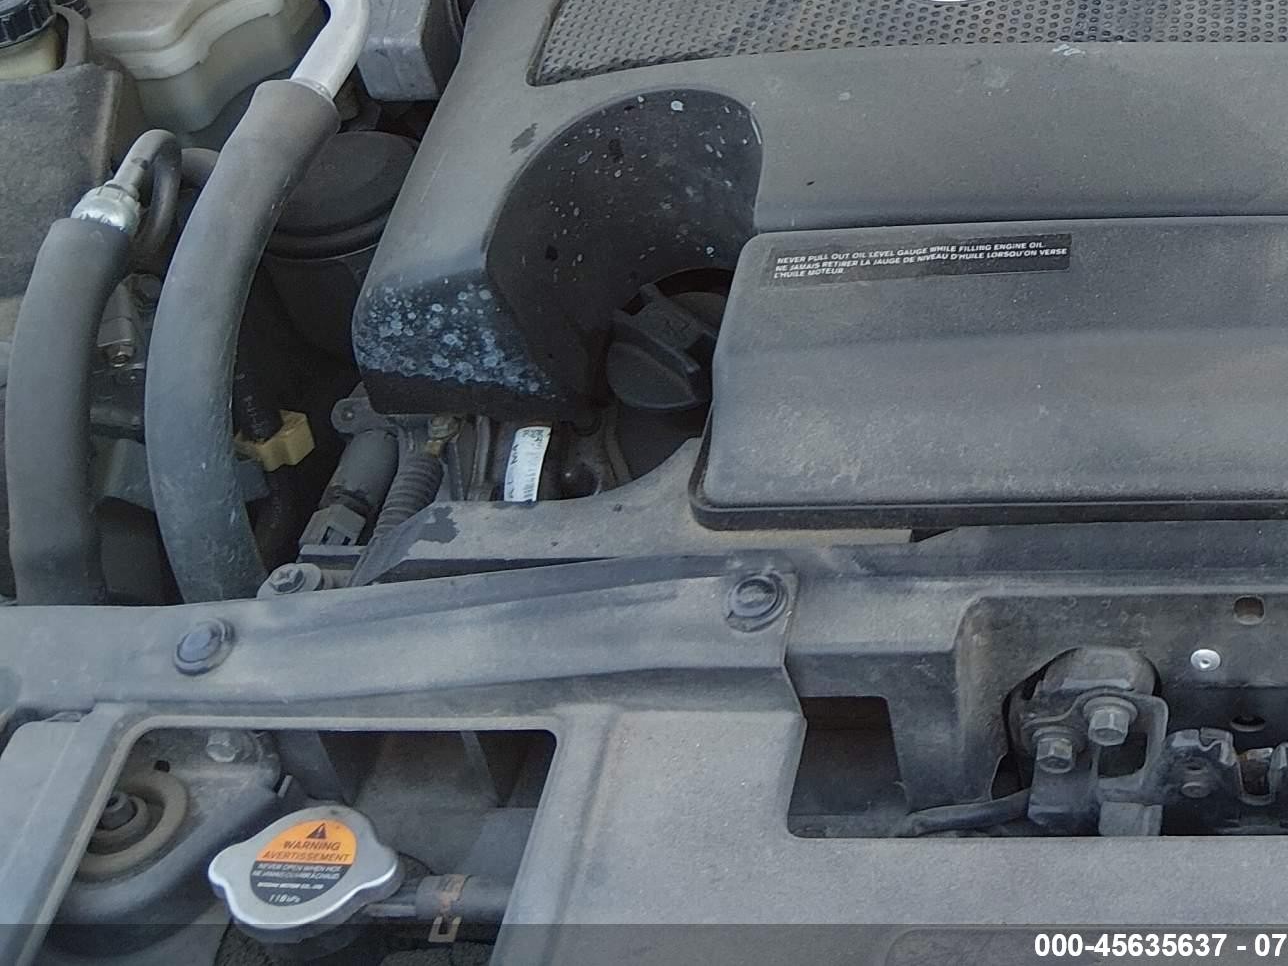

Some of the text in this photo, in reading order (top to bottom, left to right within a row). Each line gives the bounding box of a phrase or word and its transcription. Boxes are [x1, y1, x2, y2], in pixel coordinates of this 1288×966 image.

[777, 256, 806, 264] NEVER
[807, 253, 828, 262] PULL
[831, 252, 850, 260] OUT
[852, 251, 866, 259] OIL
[868, 250, 895, 258] LEVEL
[897, 247, 928, 256] GAUGE
[929, 245, 957, 253] WHILE
[958, 243, 991, 252] FILLING
[993, 242, 1027, 250] ENGINE
[789, 262, 820, 271] JAMAIS
[821, 259, 858, 268] RETIRER
[860, 258, 871, 266] LA
[873, 257, 901, 266] JAUGE
[903, 255, 915, 264] DE
[916, 252, 948, 262] NIVEAU
[1039, 247, 1068, 256] VERSE
[282, 840, 342, 851] WARNING
[262, 850, 351, 862] AVERTISSEMENT
